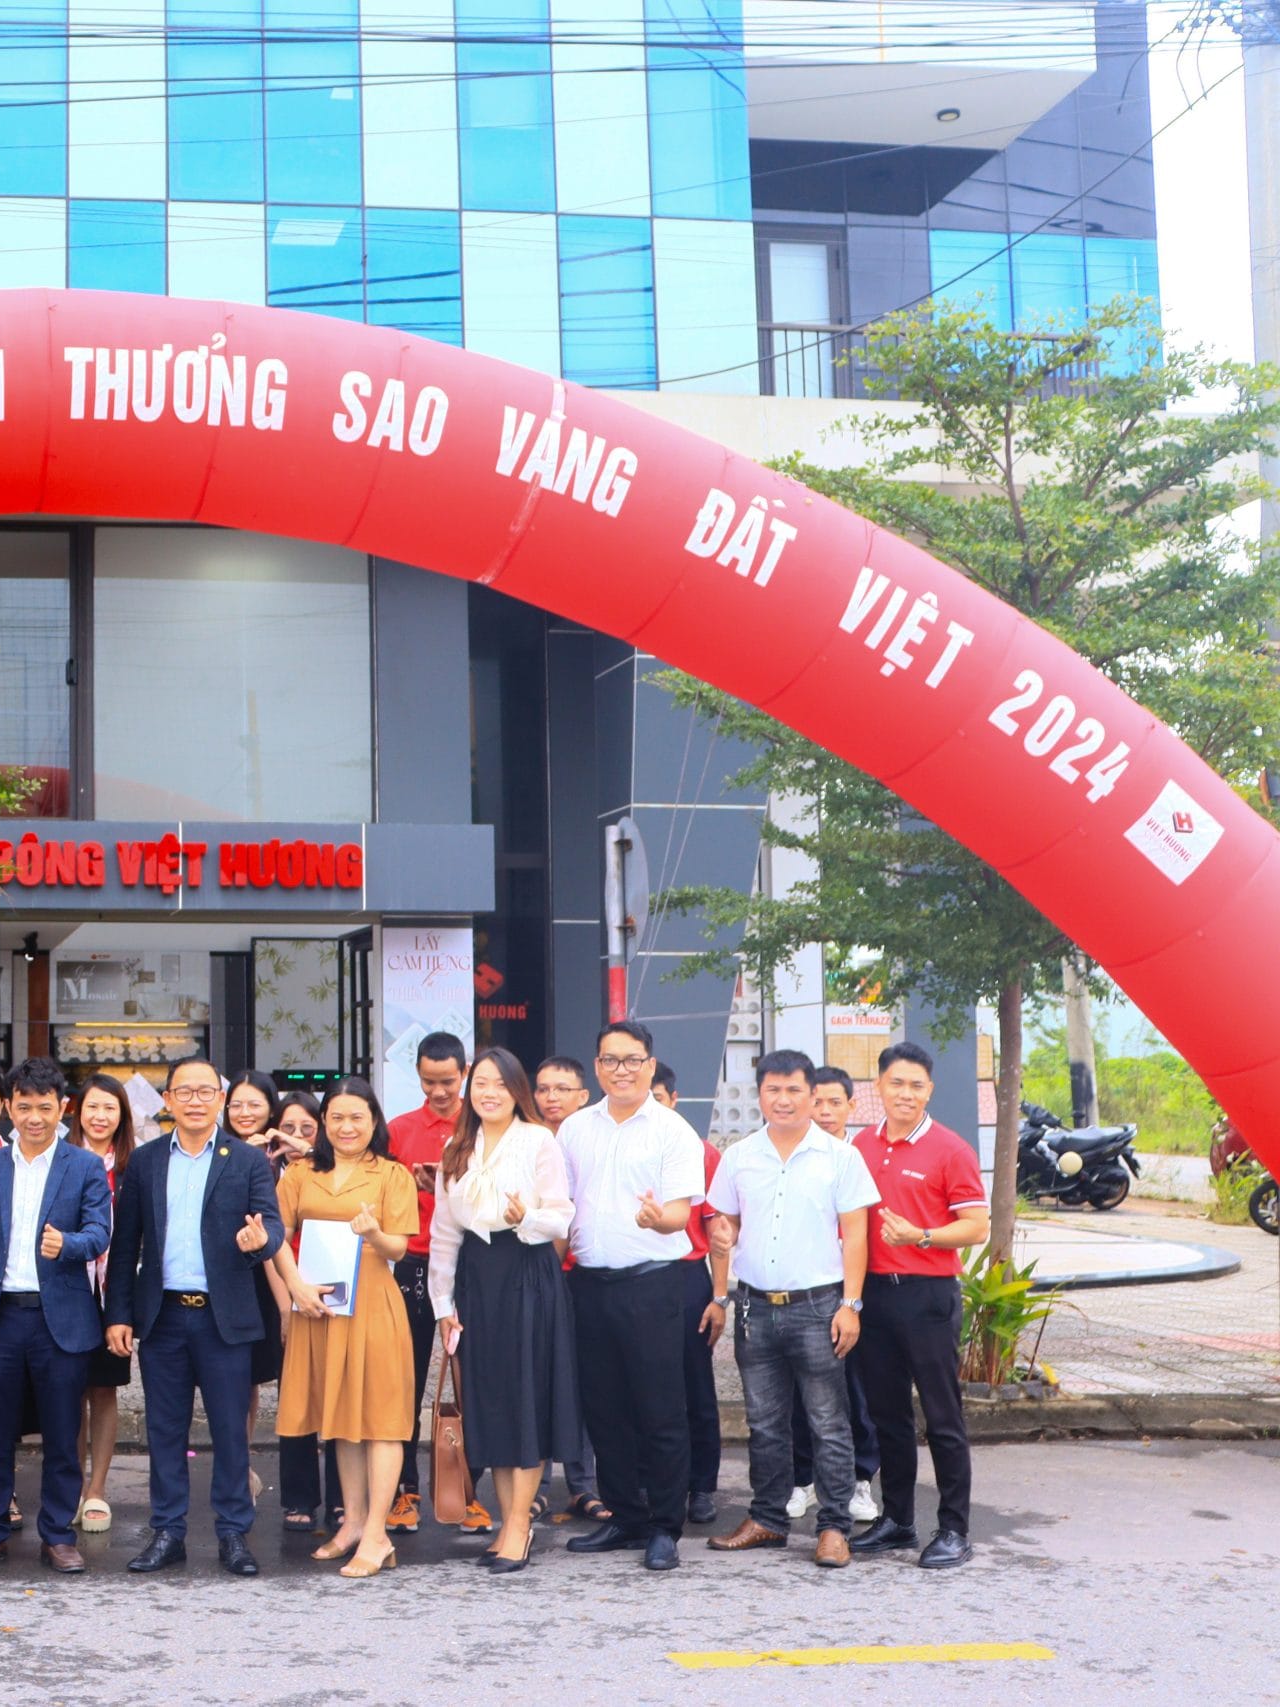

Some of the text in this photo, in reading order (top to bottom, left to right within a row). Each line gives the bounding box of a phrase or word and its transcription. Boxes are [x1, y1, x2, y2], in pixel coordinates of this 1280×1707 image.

[63, 333, 288, 431] THƯỞNG
[332, 371, 450, 456] SAO
[684, 487, 798, 588] ĐẤT
[838, 566, 974, 689] VIỆT
[988, 669, 1132, 804] 2024
[116, 832, 208, 895] VIỆT
[218, 838, 363, 889] HƯƠNG
[1146, 817, 1166, 837] VIET
[1163, 834, 1192, 862] HUONG
[479, 1004, 527, 1020] HUONG
